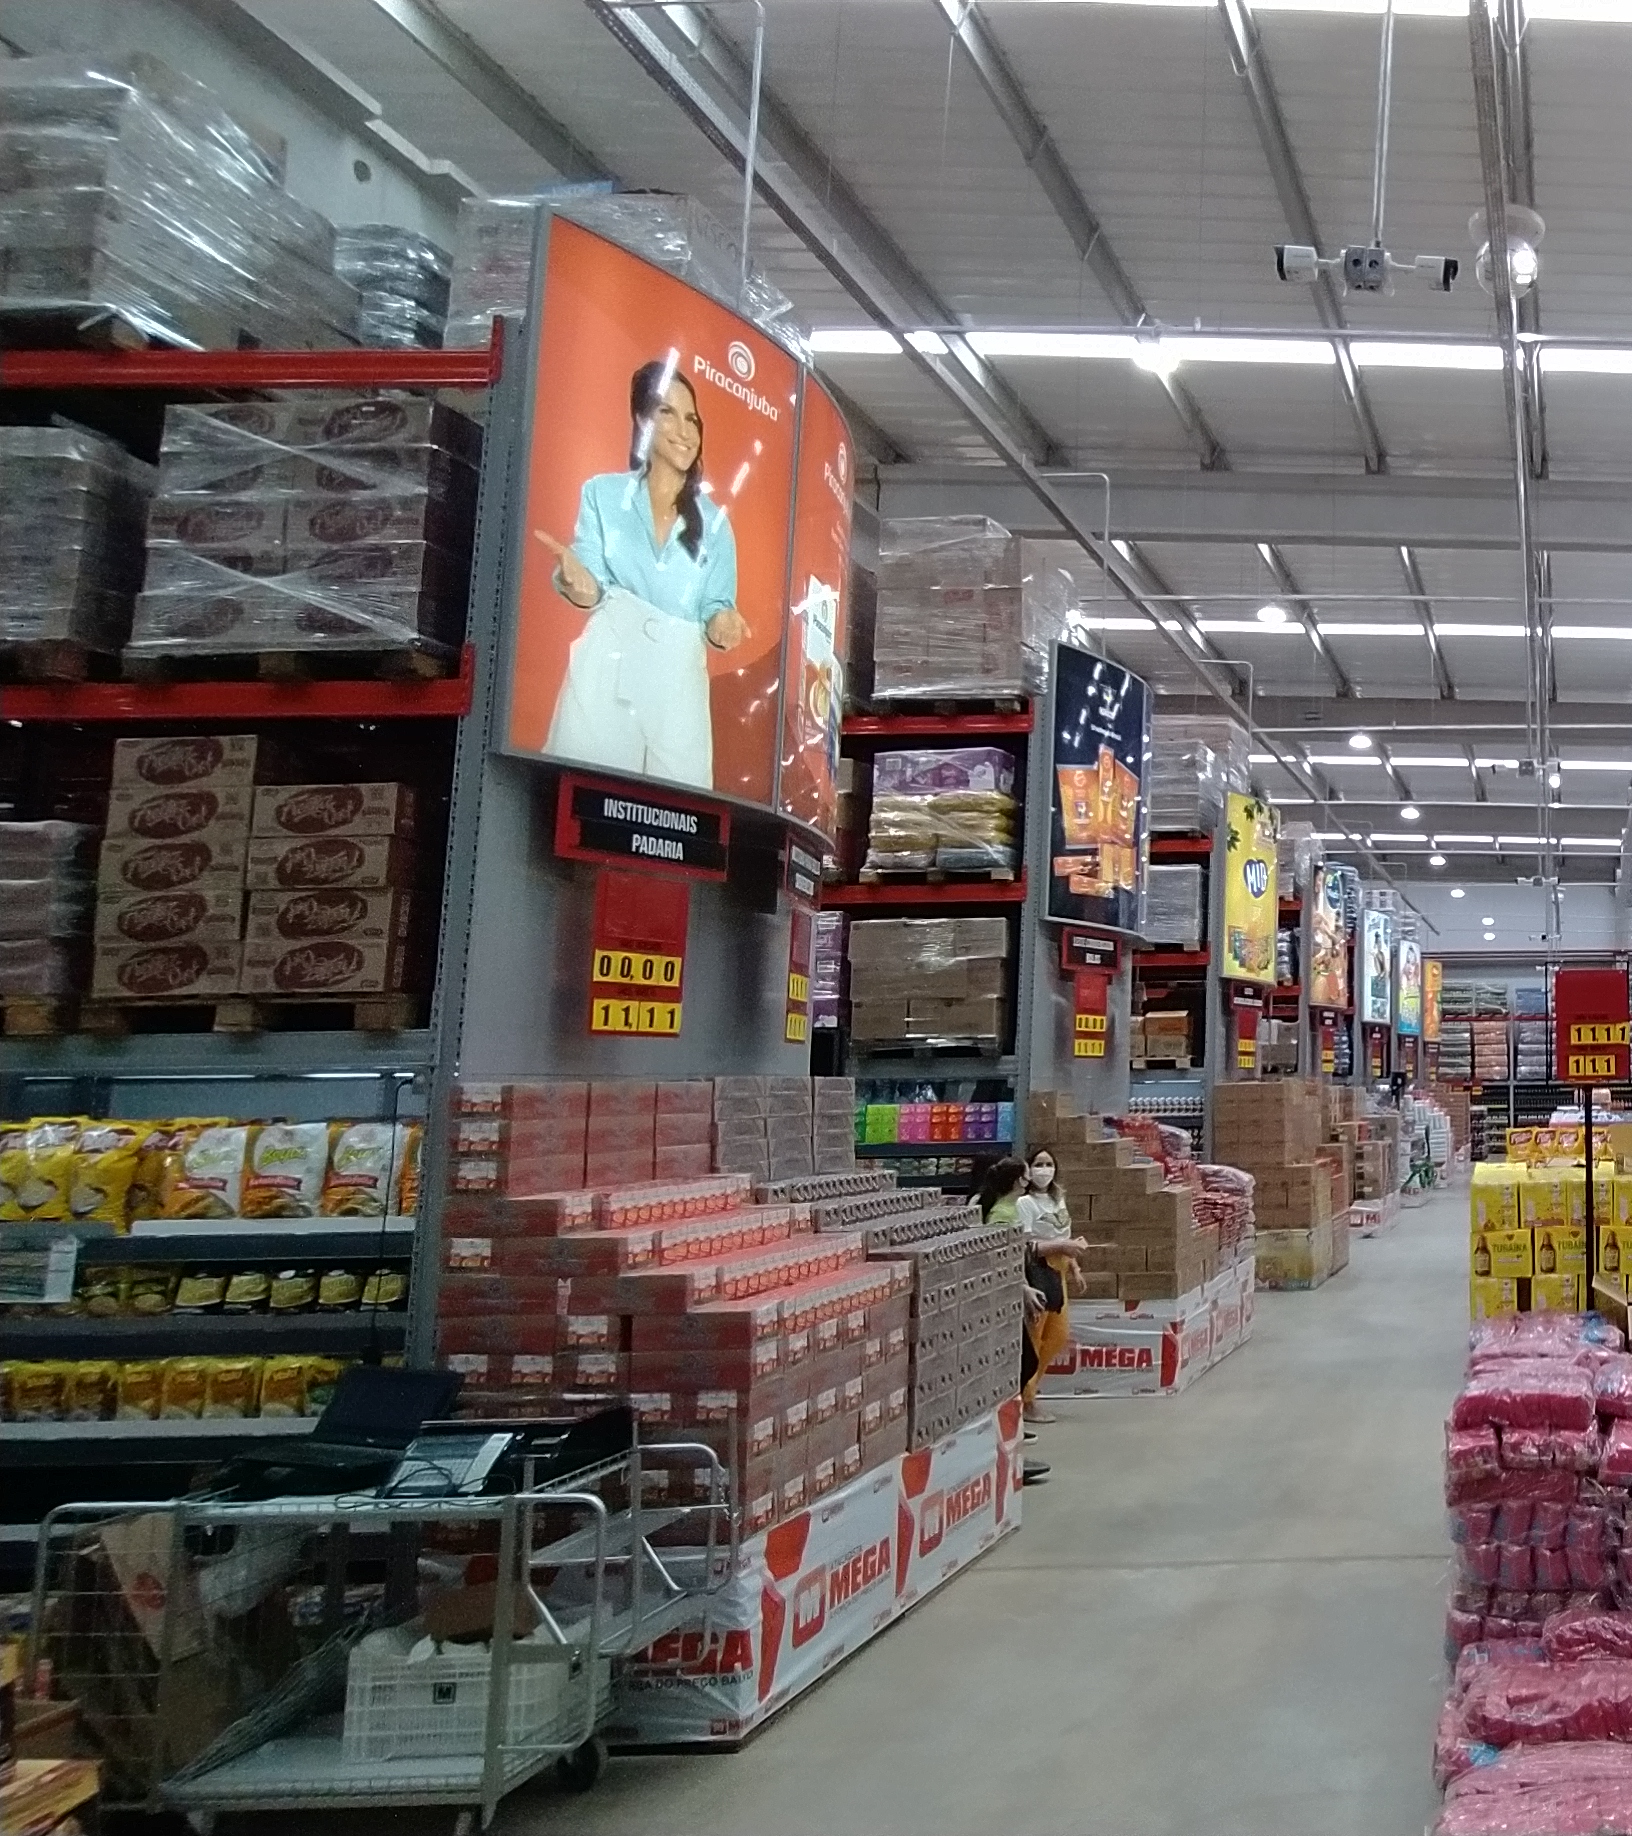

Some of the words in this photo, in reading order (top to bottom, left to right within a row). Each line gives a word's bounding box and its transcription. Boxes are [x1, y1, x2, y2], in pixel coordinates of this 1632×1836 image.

[693, 355, 778, 422] Piracanjuba
[603, 797, 699, 835] INSTITUCIONAIS
[631, 833, 684, 861] PADARIA
[599, 954, 676, 982] 00,00
[600, 1003, 677, 1031] 11,11
[1079, 1347, 1154, 1369] MEGA
[945, 1471, 992, 1530] MEGA
[829, 1536, 891, 1610] MEGA
